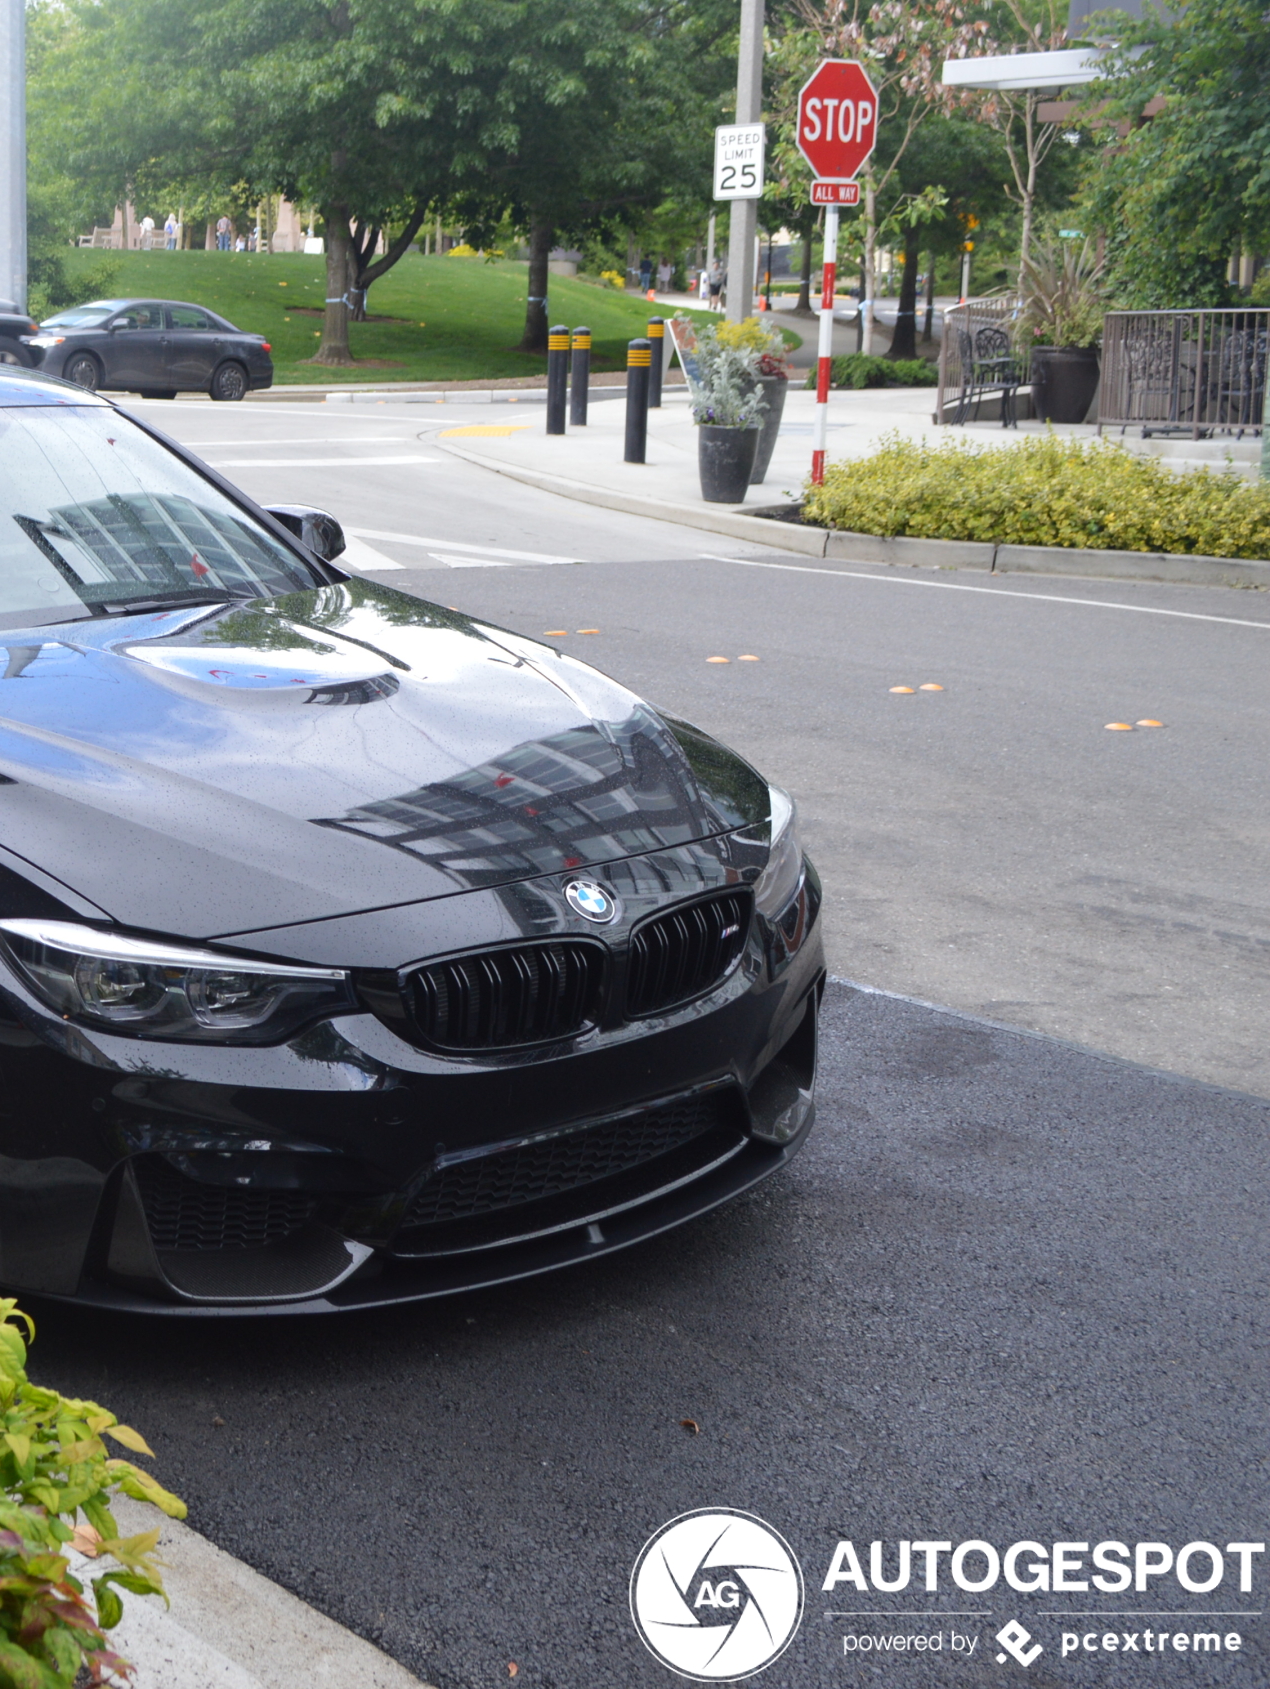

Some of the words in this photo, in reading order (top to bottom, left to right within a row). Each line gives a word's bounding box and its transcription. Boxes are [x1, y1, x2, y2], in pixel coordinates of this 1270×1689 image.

[803, 97, 873, 143] STOP
[720, 133, 760, 146] SPEED
[725, 147, 754, 160] LIMIT
[720, 164, 757, 190] 25
[815, 187, 834, 200] ALL
[839, 187, 857, 200] WAY
